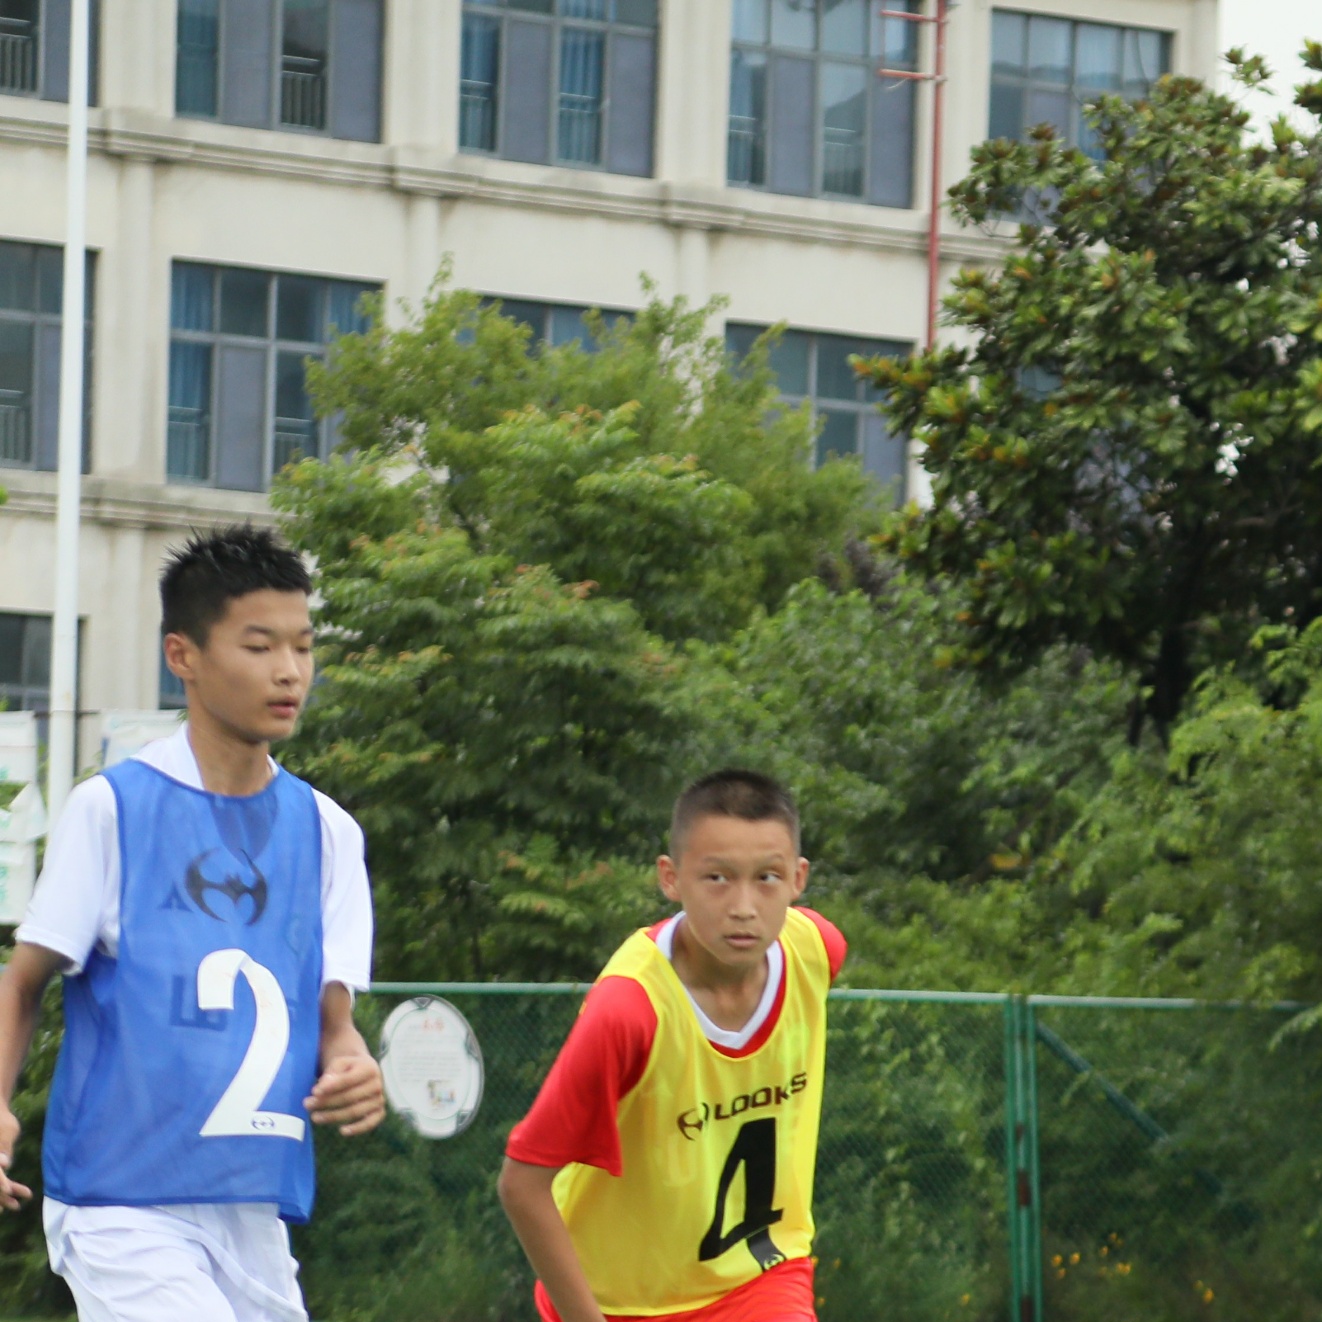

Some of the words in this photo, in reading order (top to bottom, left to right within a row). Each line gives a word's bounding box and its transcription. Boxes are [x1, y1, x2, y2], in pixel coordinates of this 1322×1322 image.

[197, 948, 306, 1142] 2
[714, 1072, 807, 1120] LOOKS
[698, 1117, 786, 1272] 4
